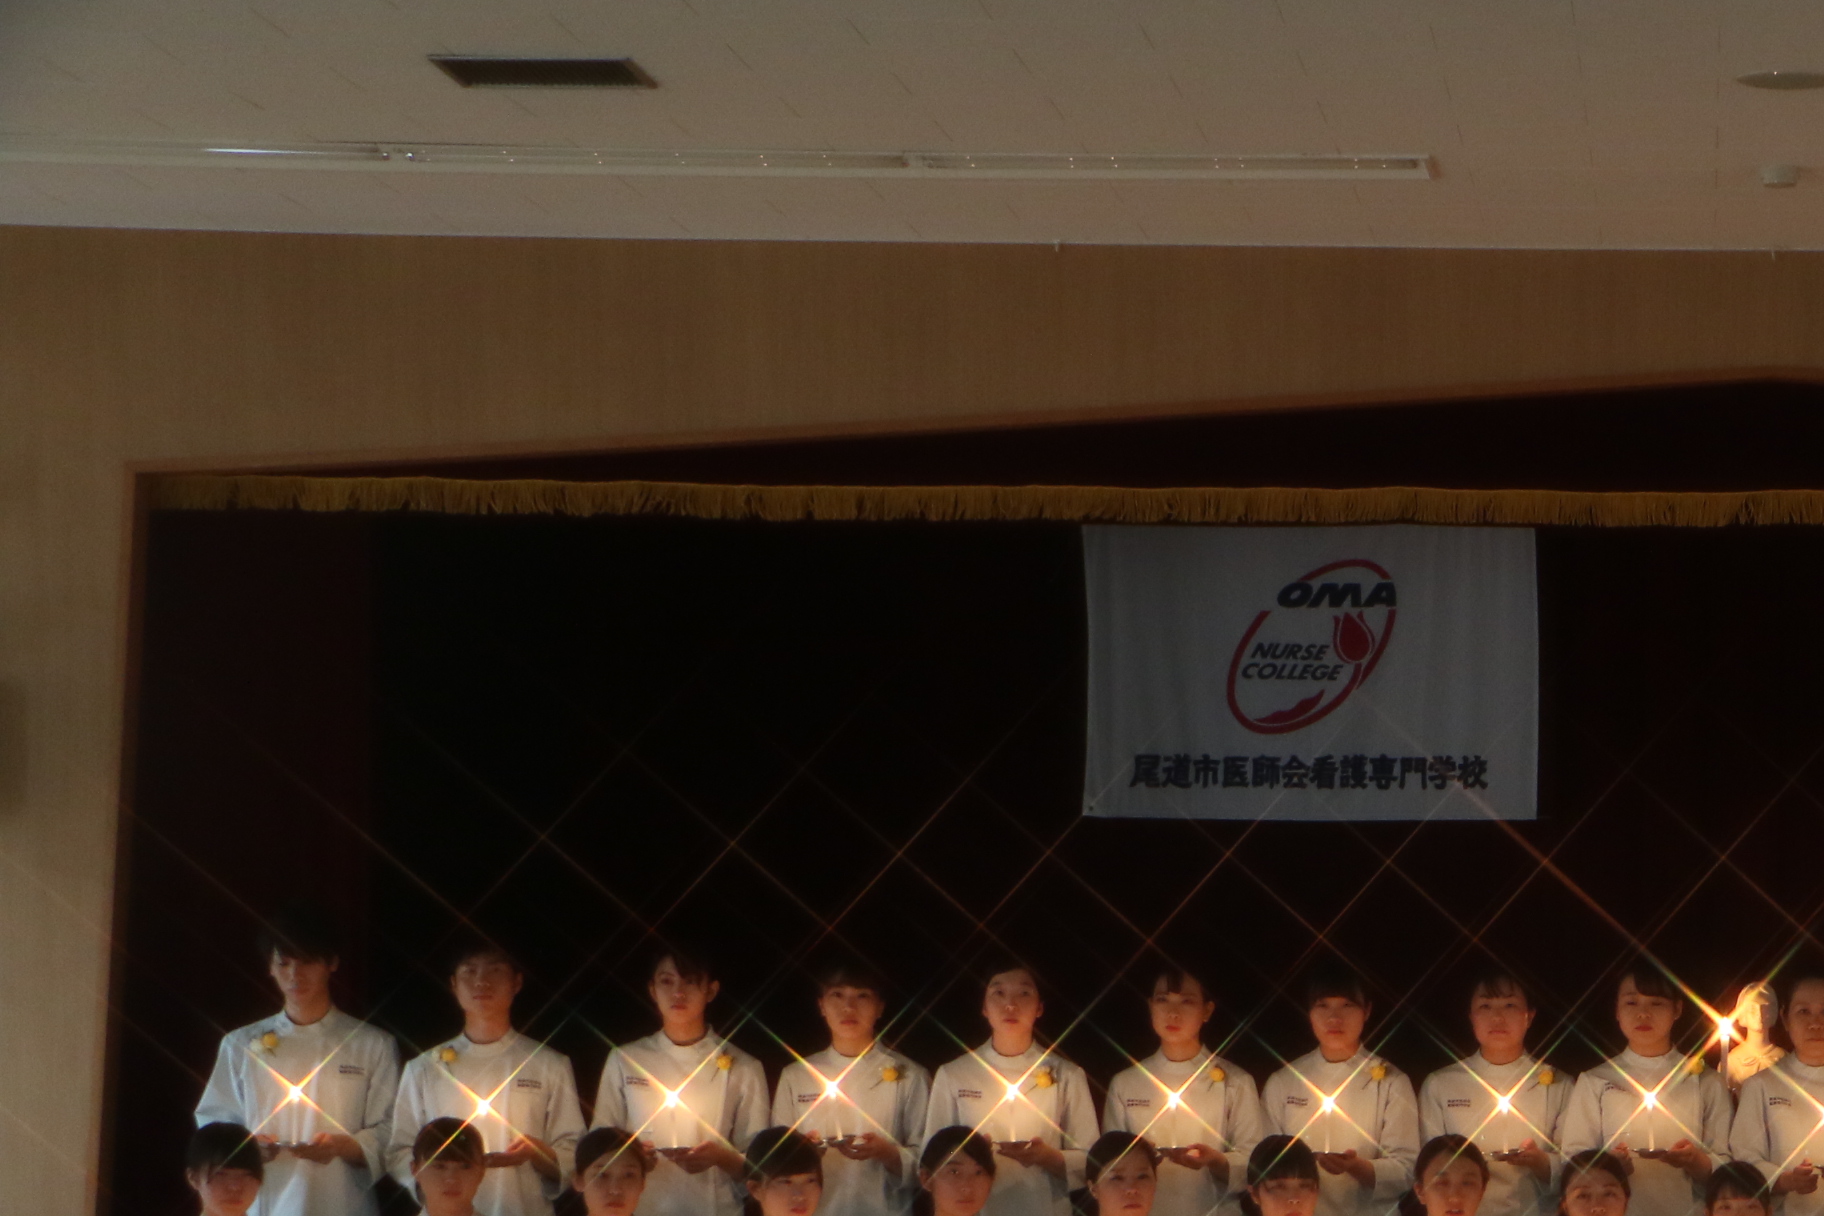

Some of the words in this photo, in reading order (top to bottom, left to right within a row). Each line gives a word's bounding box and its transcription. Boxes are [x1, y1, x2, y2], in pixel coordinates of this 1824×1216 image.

[1277, 581, 1397, 608] OMA
[1251, 642, 1329, 661] NURSE
[1241, 662, 1344, 681] COLLEGE
[1129, 753, 1489, 791] 尾道市医師会看護専門学校
